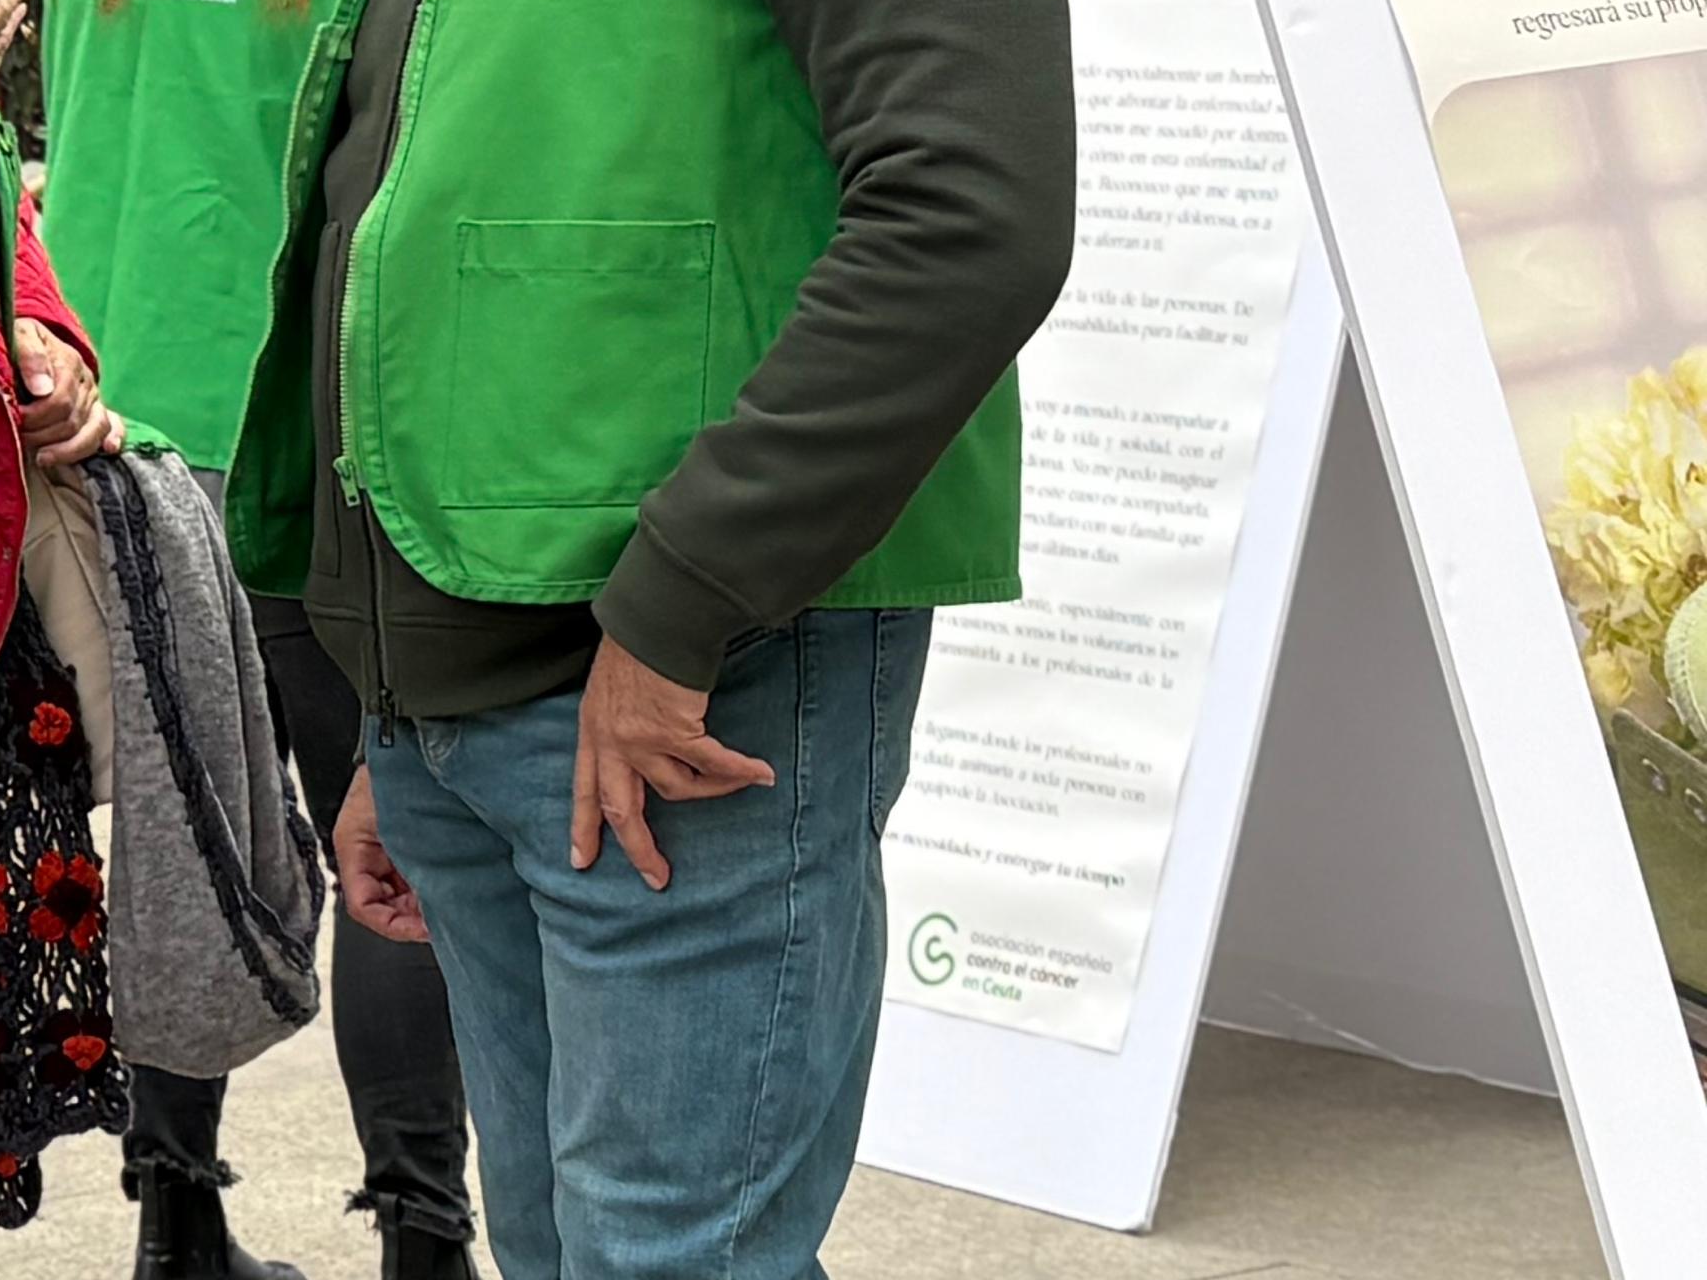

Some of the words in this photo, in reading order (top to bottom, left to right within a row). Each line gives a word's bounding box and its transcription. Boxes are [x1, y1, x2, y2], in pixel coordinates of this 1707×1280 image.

[1512, 0, 1622, 41] regresará
[1624, 0, 1653, 20] su
[967, 952, 1011, 976] contra
[1015, 963, 1027, 977] el
[1030, 967, 1079, 989] cáncer
[971, 931, 1044, 957] asociación
[1048, 948, 1113, 975] española
[962, 975, 979, 992] en
[982, 977, 1022, 1002] Ceuta
